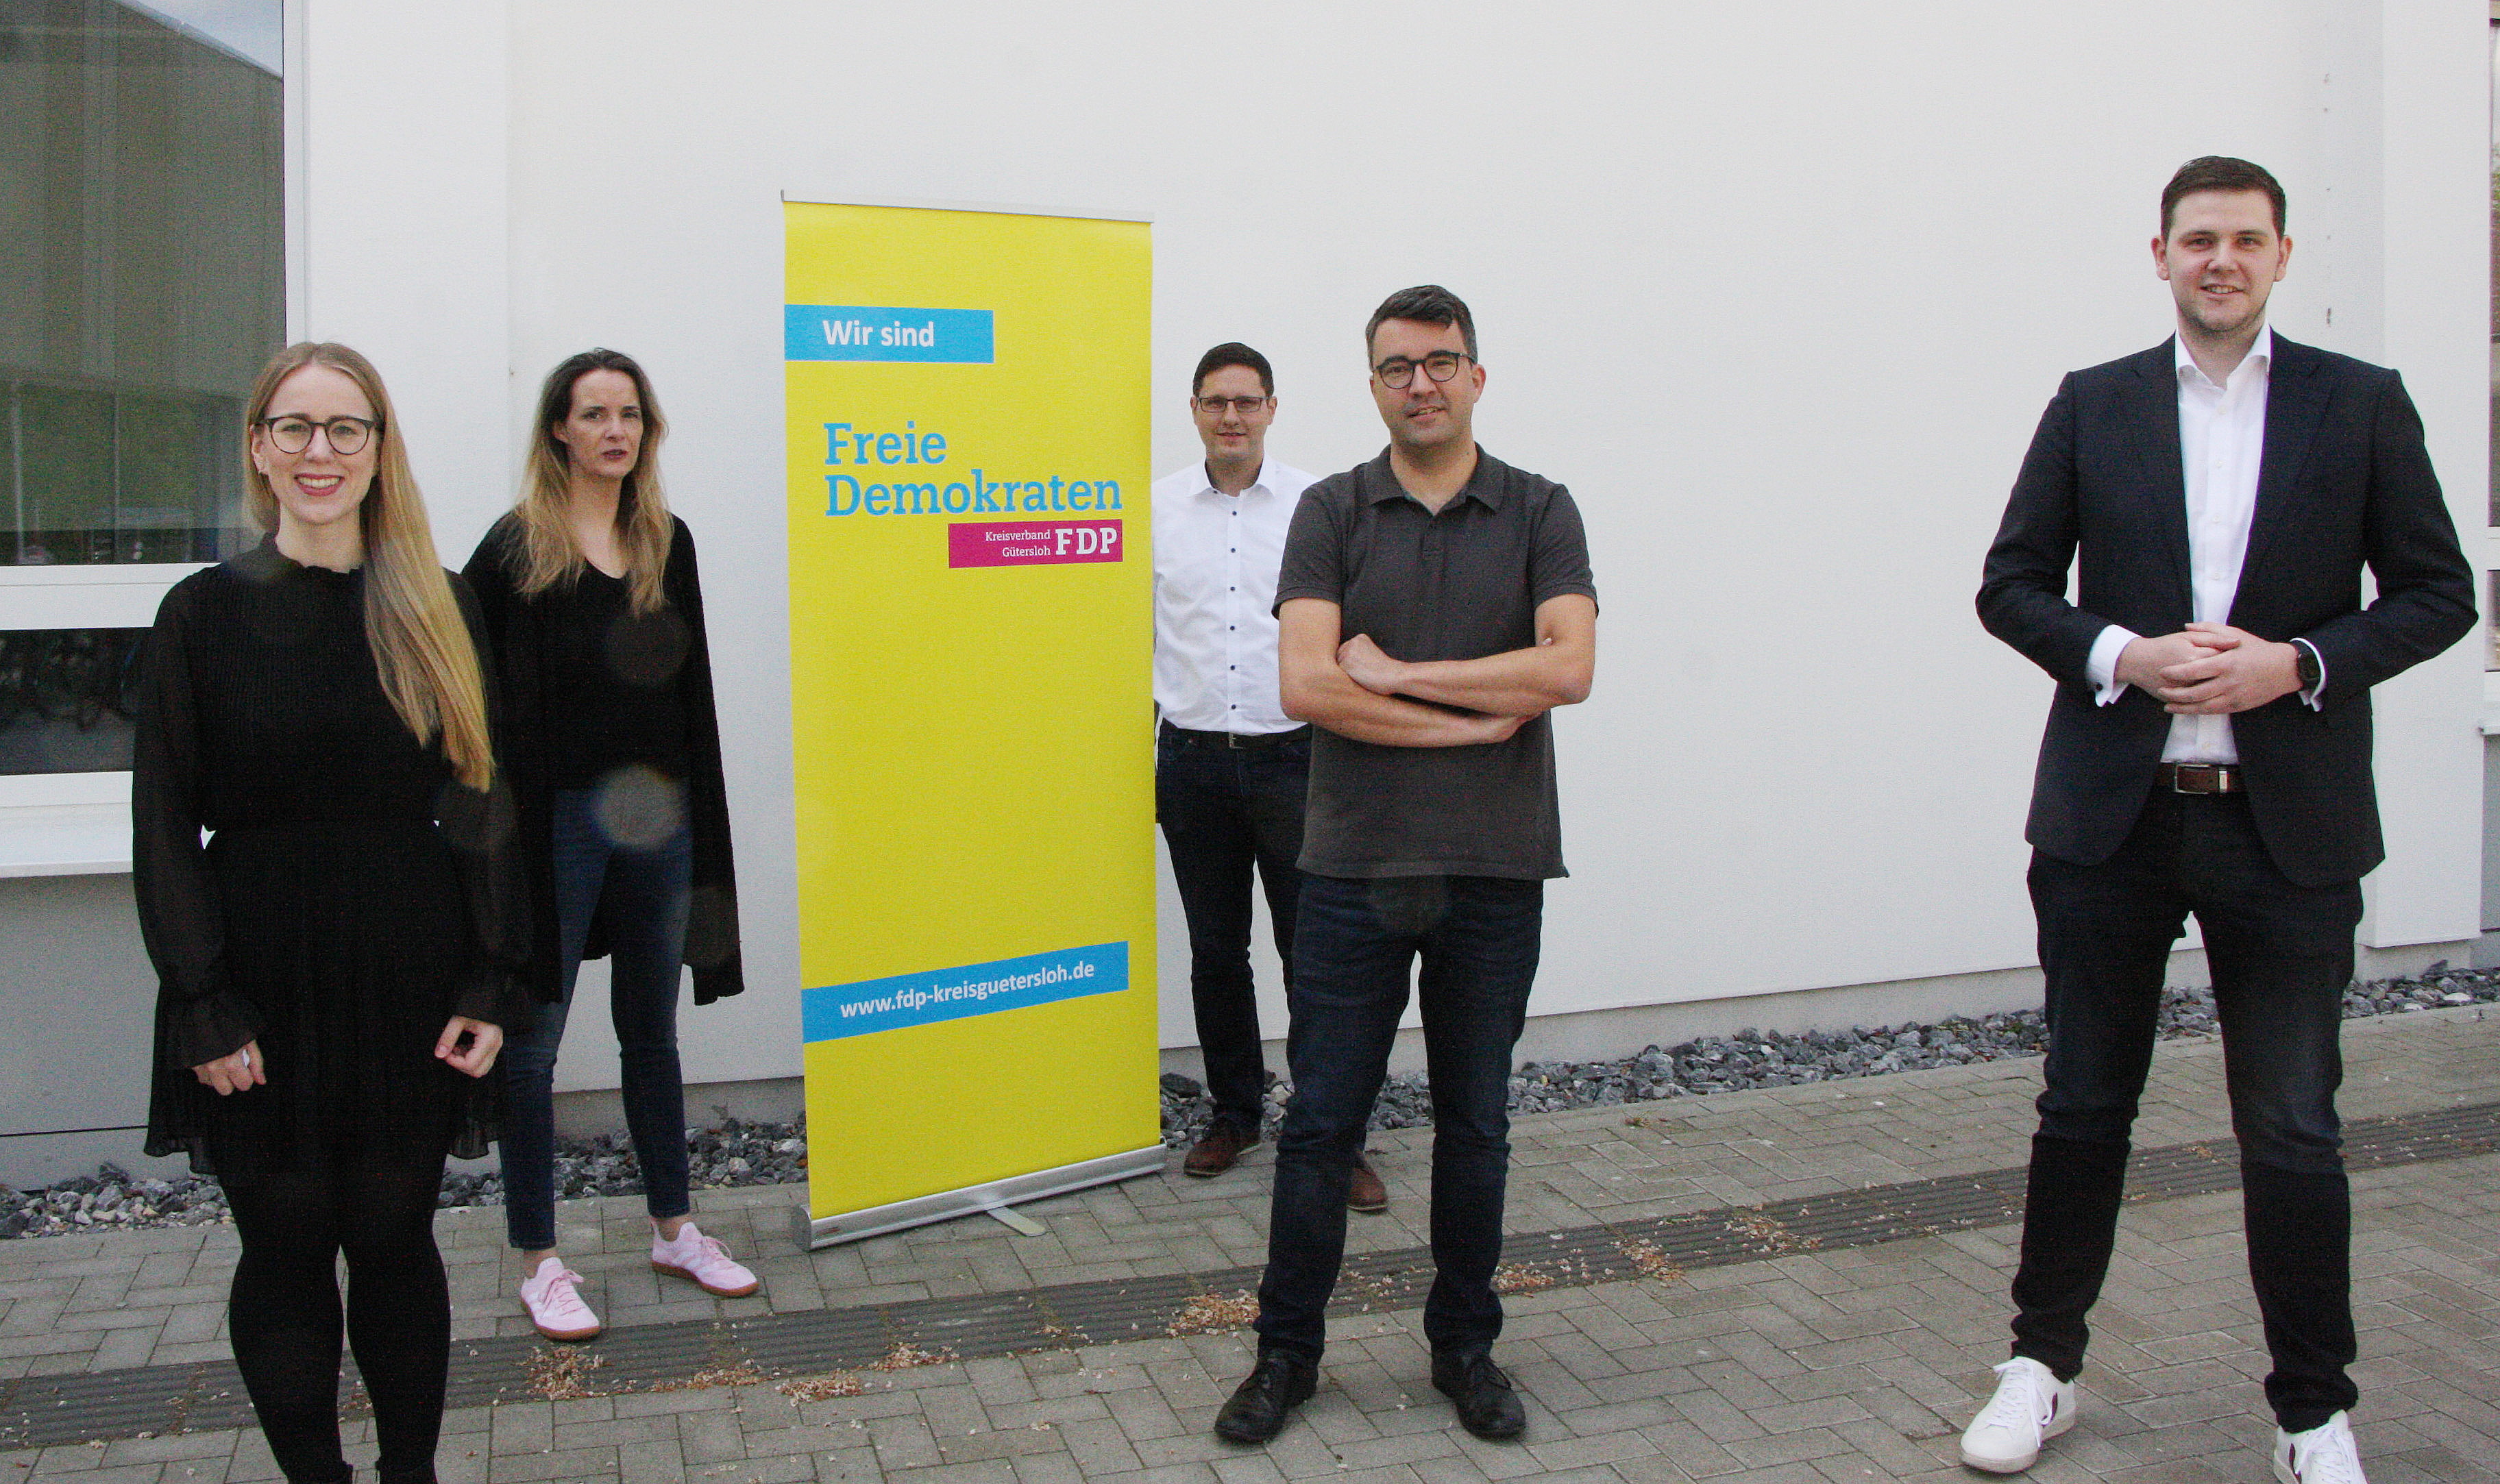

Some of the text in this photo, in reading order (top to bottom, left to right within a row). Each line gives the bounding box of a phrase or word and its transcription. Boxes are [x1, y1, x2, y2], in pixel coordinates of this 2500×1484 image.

[823, 320, 935, 347] Wir sind
[824, 421, 947, 465] Freie
[824, 469, 1123, 517] Demokraten
[985, 530, 1051, 541] Kreisverband
[1055, 527, 1118, 556] FDP
[1003, 545, 1051, 558] Gütersloh
[840, 961, 1095, 1017] www.fdp-kreisguetersloh.de
